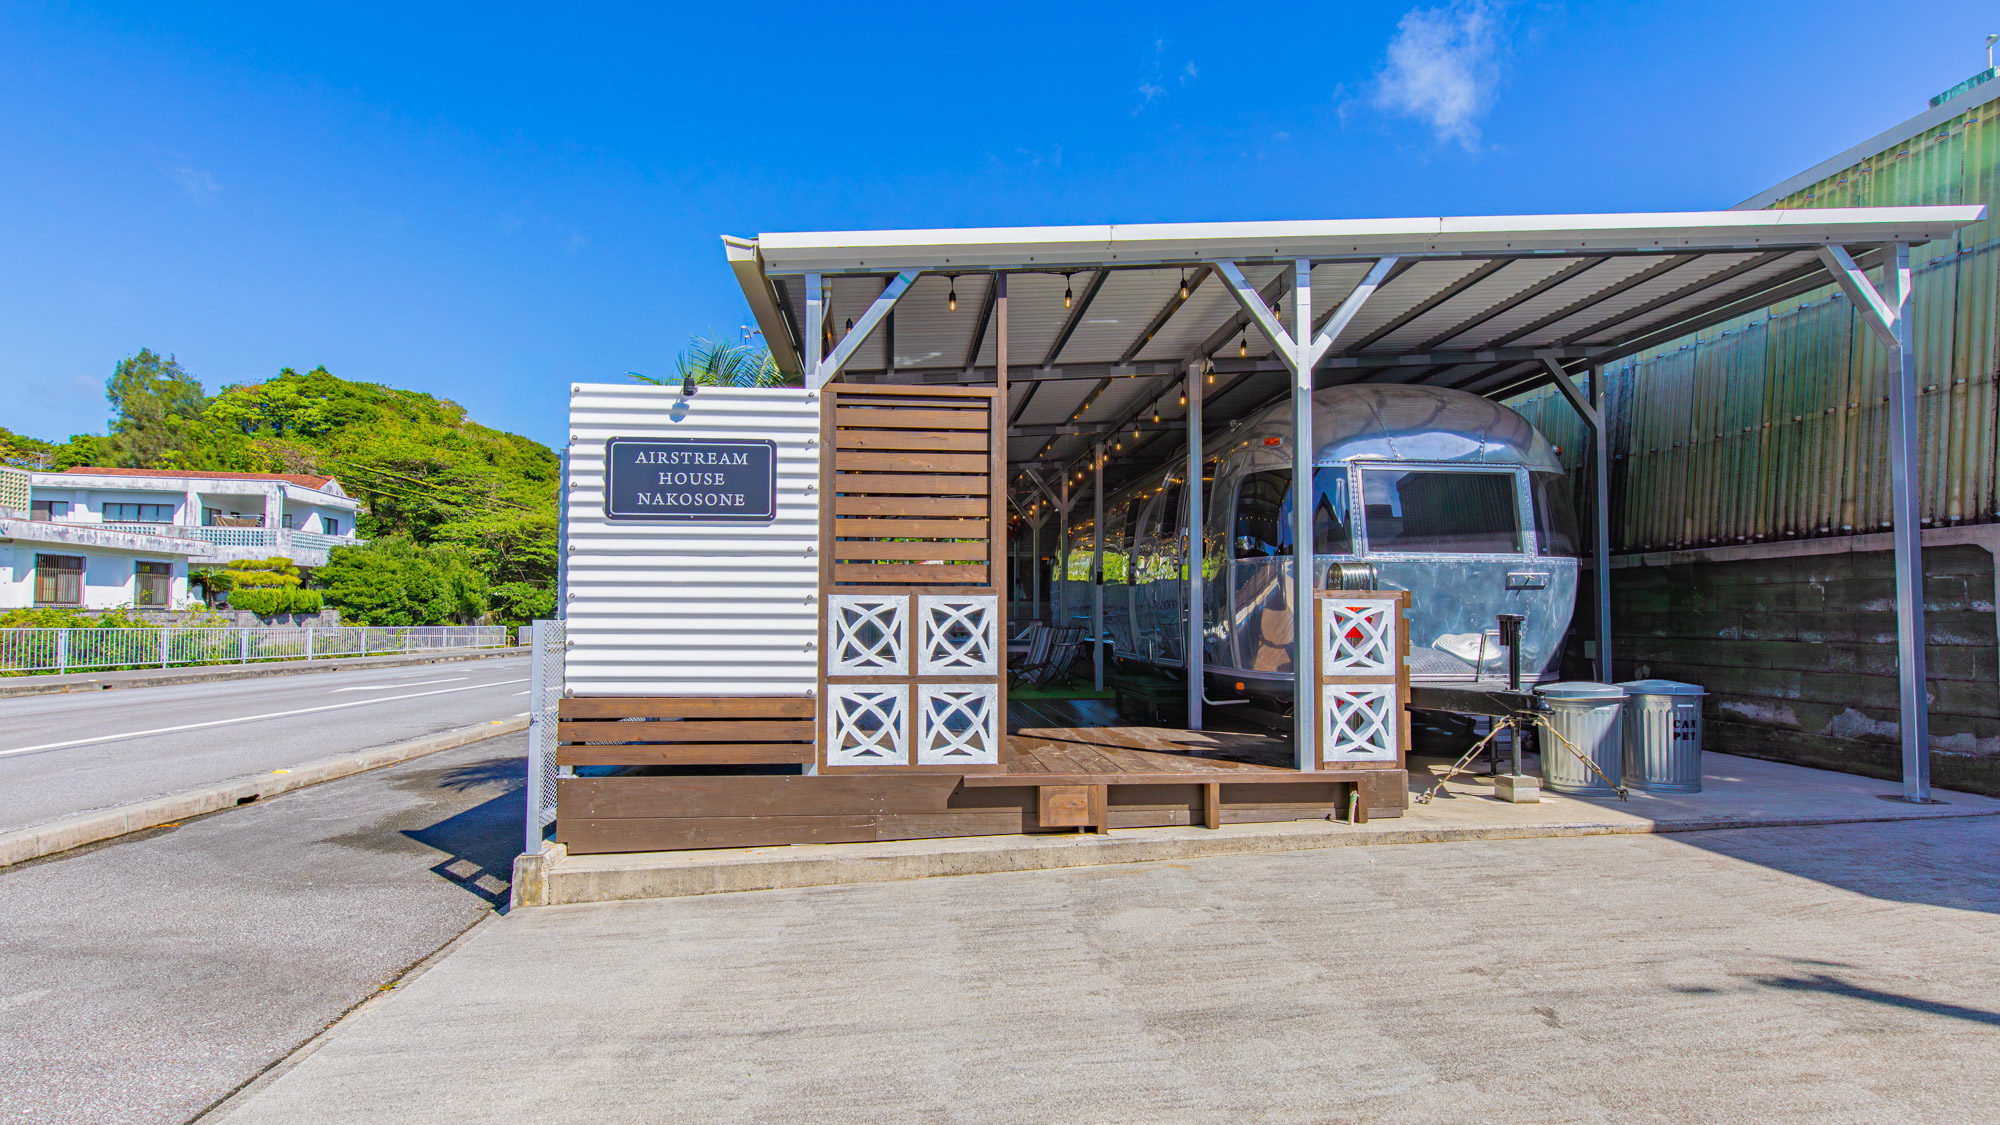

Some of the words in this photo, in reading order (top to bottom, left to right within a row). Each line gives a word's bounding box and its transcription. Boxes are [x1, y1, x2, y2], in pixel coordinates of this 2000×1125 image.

[635, 451, 748, 465] AIRSTREAM
[658, 472, 725, 485] HOUSE
[637, 492, 745, 506] NAKOSONE
[1673, 719, 1696, 728] CAN
[1673, 731, 1696, 740] PET
